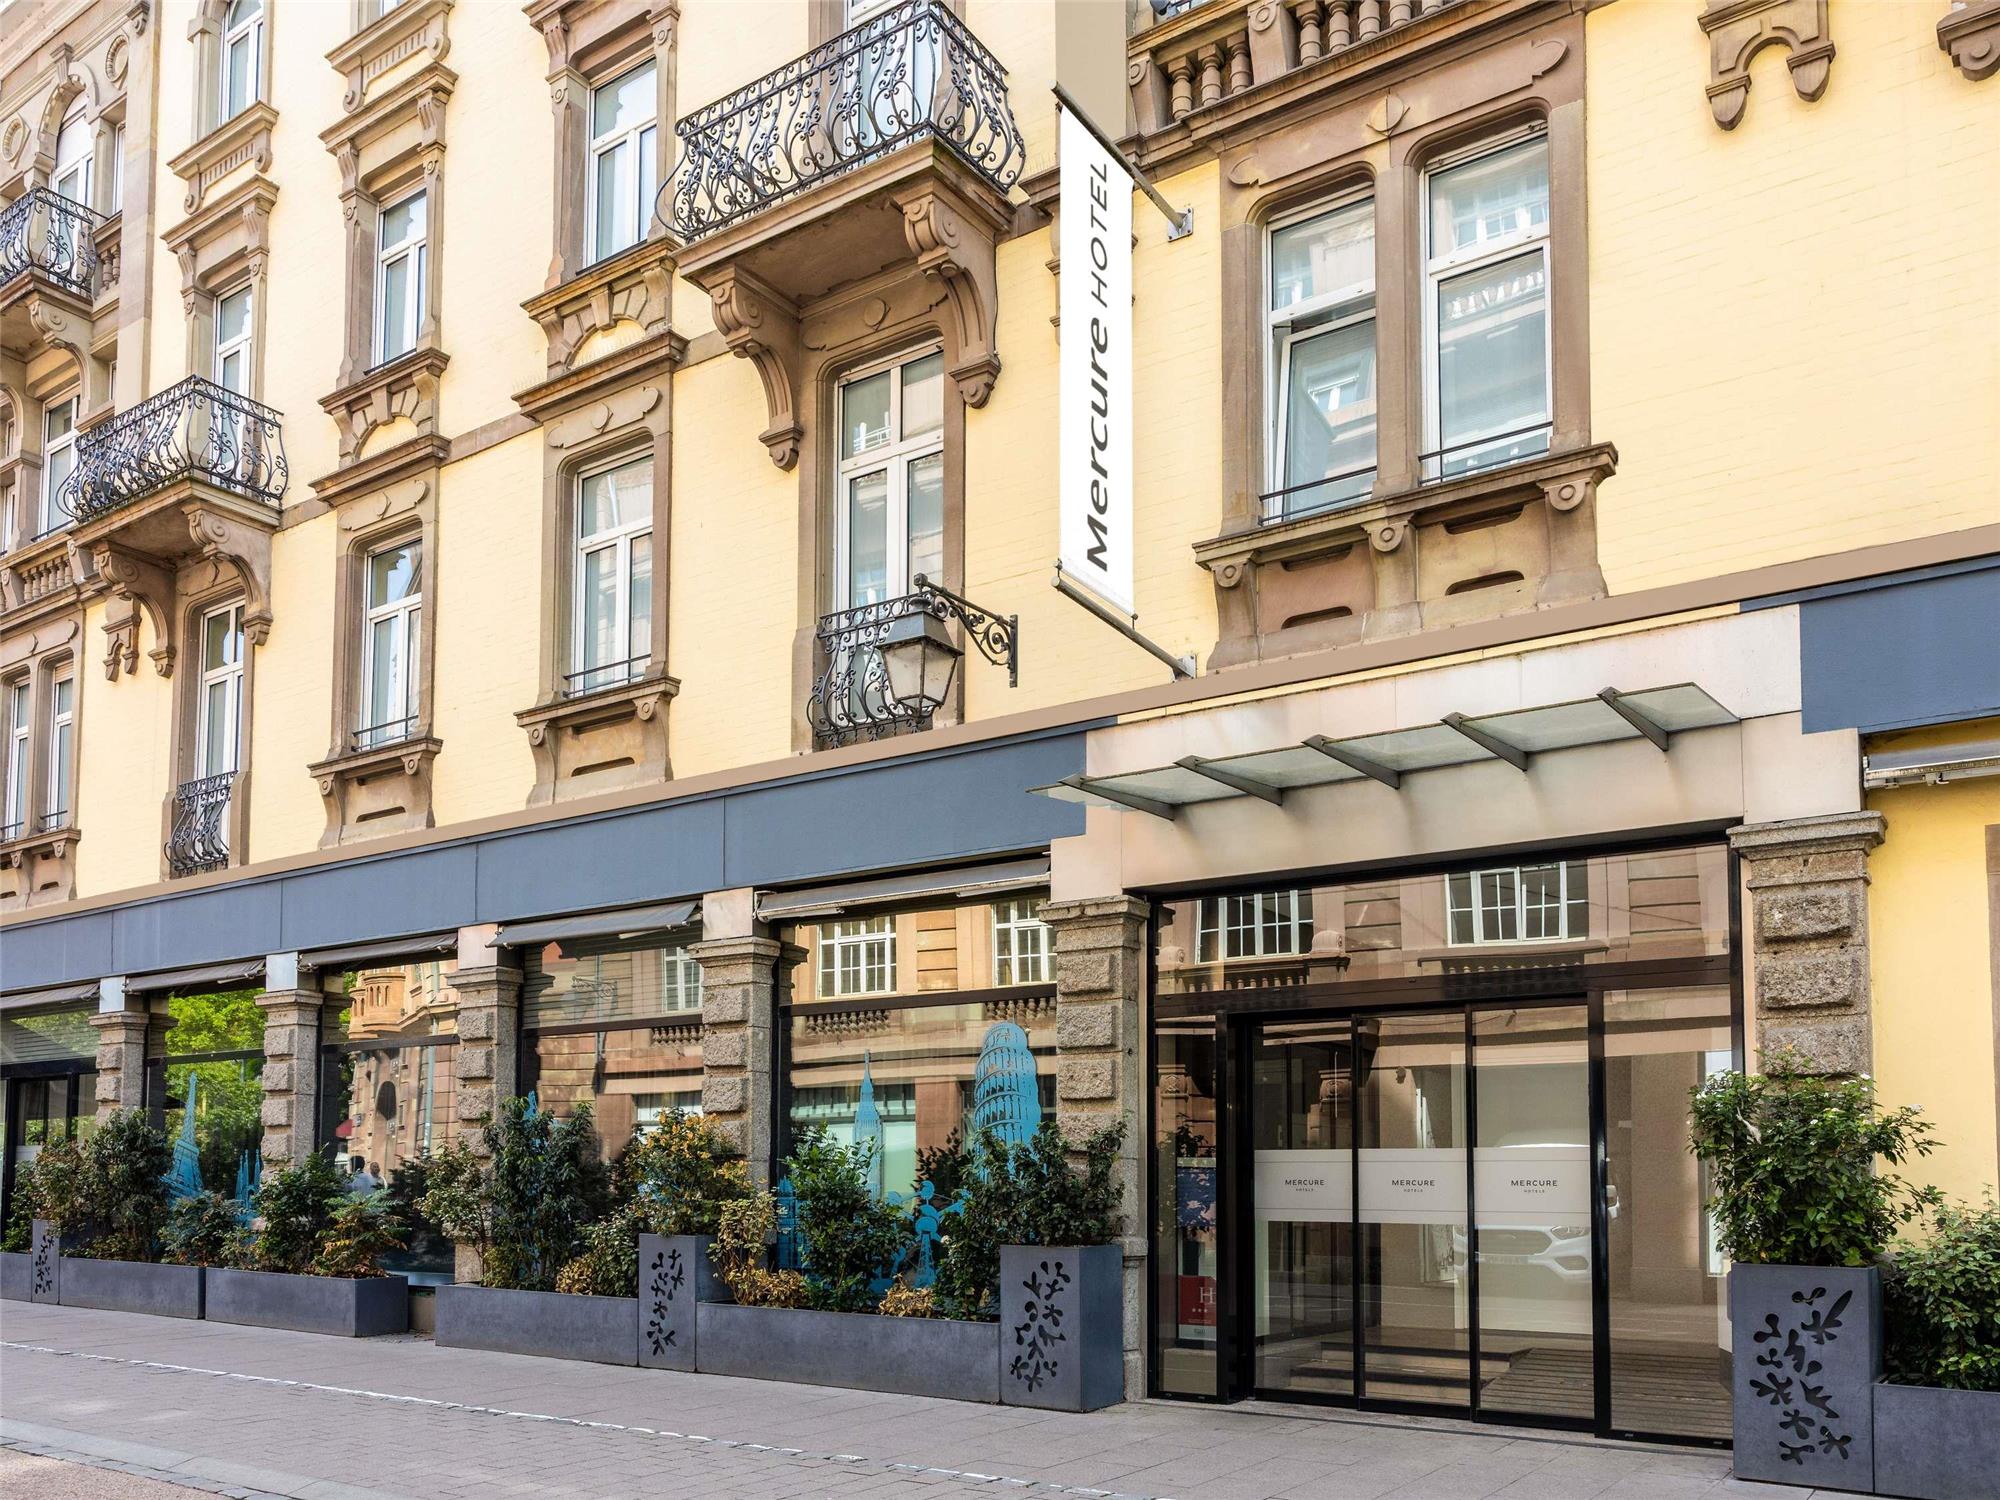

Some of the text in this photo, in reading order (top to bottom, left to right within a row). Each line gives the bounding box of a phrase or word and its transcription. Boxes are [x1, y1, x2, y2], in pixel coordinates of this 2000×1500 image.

[1086, 162, 1109, 572] Mercure HOTEL
[1391, 1179, 1436, 1187] MERCURE
[1510, 1179, 1558, 1187] MERCURE
